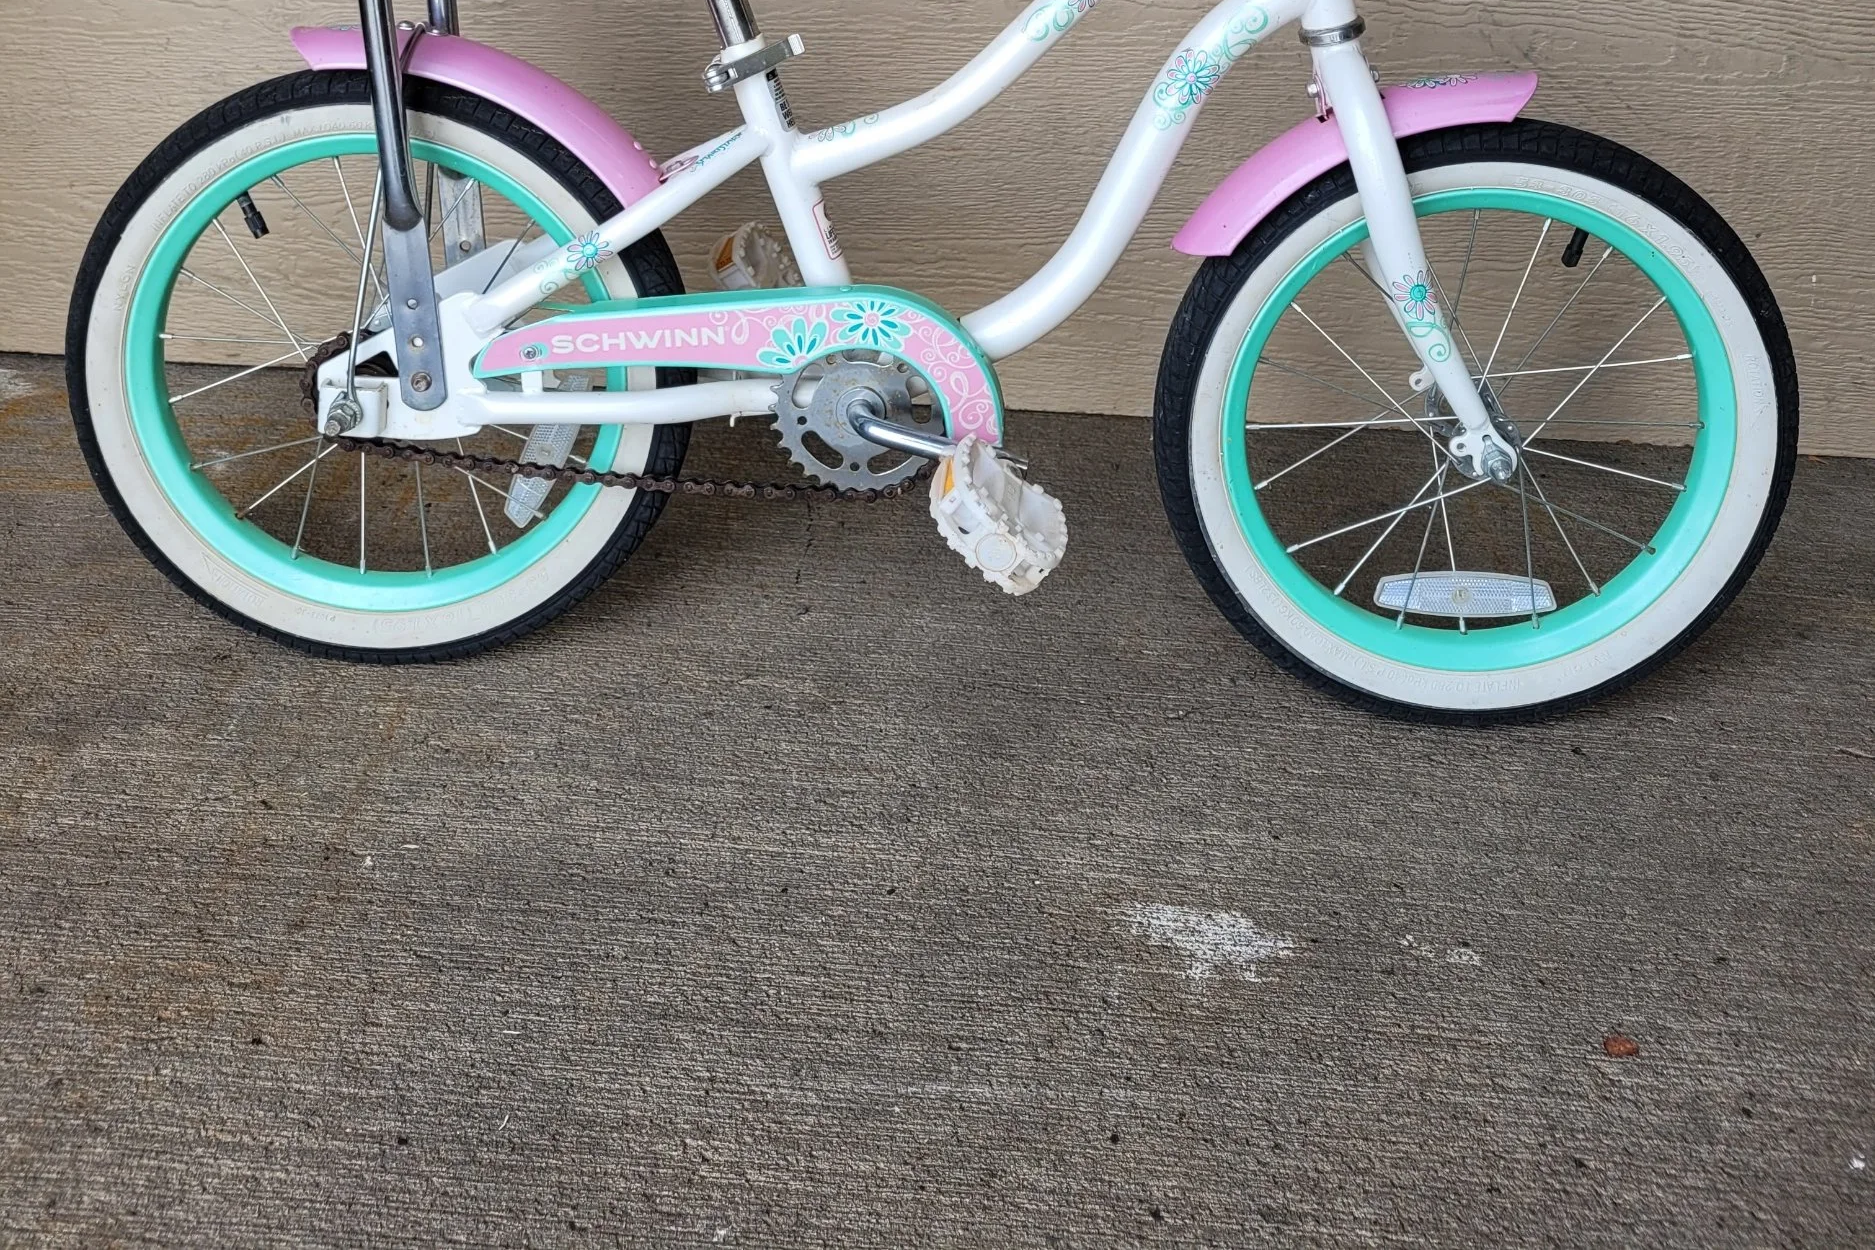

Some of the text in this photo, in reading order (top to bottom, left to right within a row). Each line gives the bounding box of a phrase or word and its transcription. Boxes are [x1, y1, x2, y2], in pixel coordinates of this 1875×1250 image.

[152, 194, 187, 232] INFLATE
[181, 180, 199, 197] TO
[552, 325, 725, 354] SCHWINN
